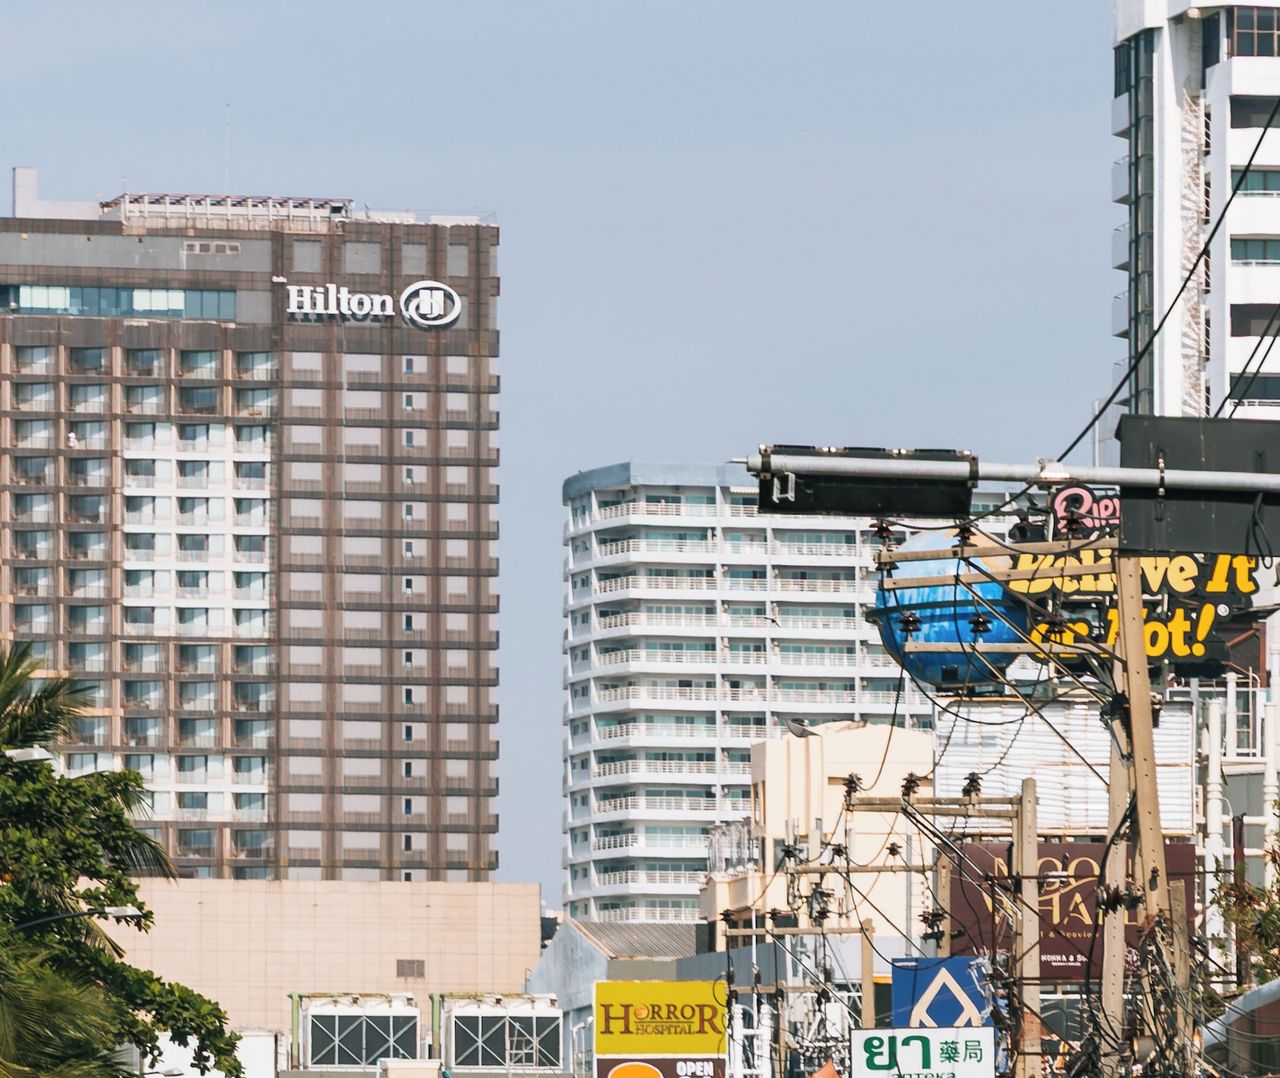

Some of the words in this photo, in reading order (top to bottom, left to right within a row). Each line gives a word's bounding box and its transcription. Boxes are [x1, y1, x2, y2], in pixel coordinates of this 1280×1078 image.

[287, 283, 395, 316] Hilton
[1008, 549, 1198, 593] Belive
[1206, 555, 1256, 593] It
[600, 1004, 723, 1035] HORROR
[634, 1024, 696, 1035] HOSPITAL
[863, 1035, 931, 1070] ยา
[939, 1040, 983, 1064] 藥局
[676, 1061, 714, 1076] OPEN
